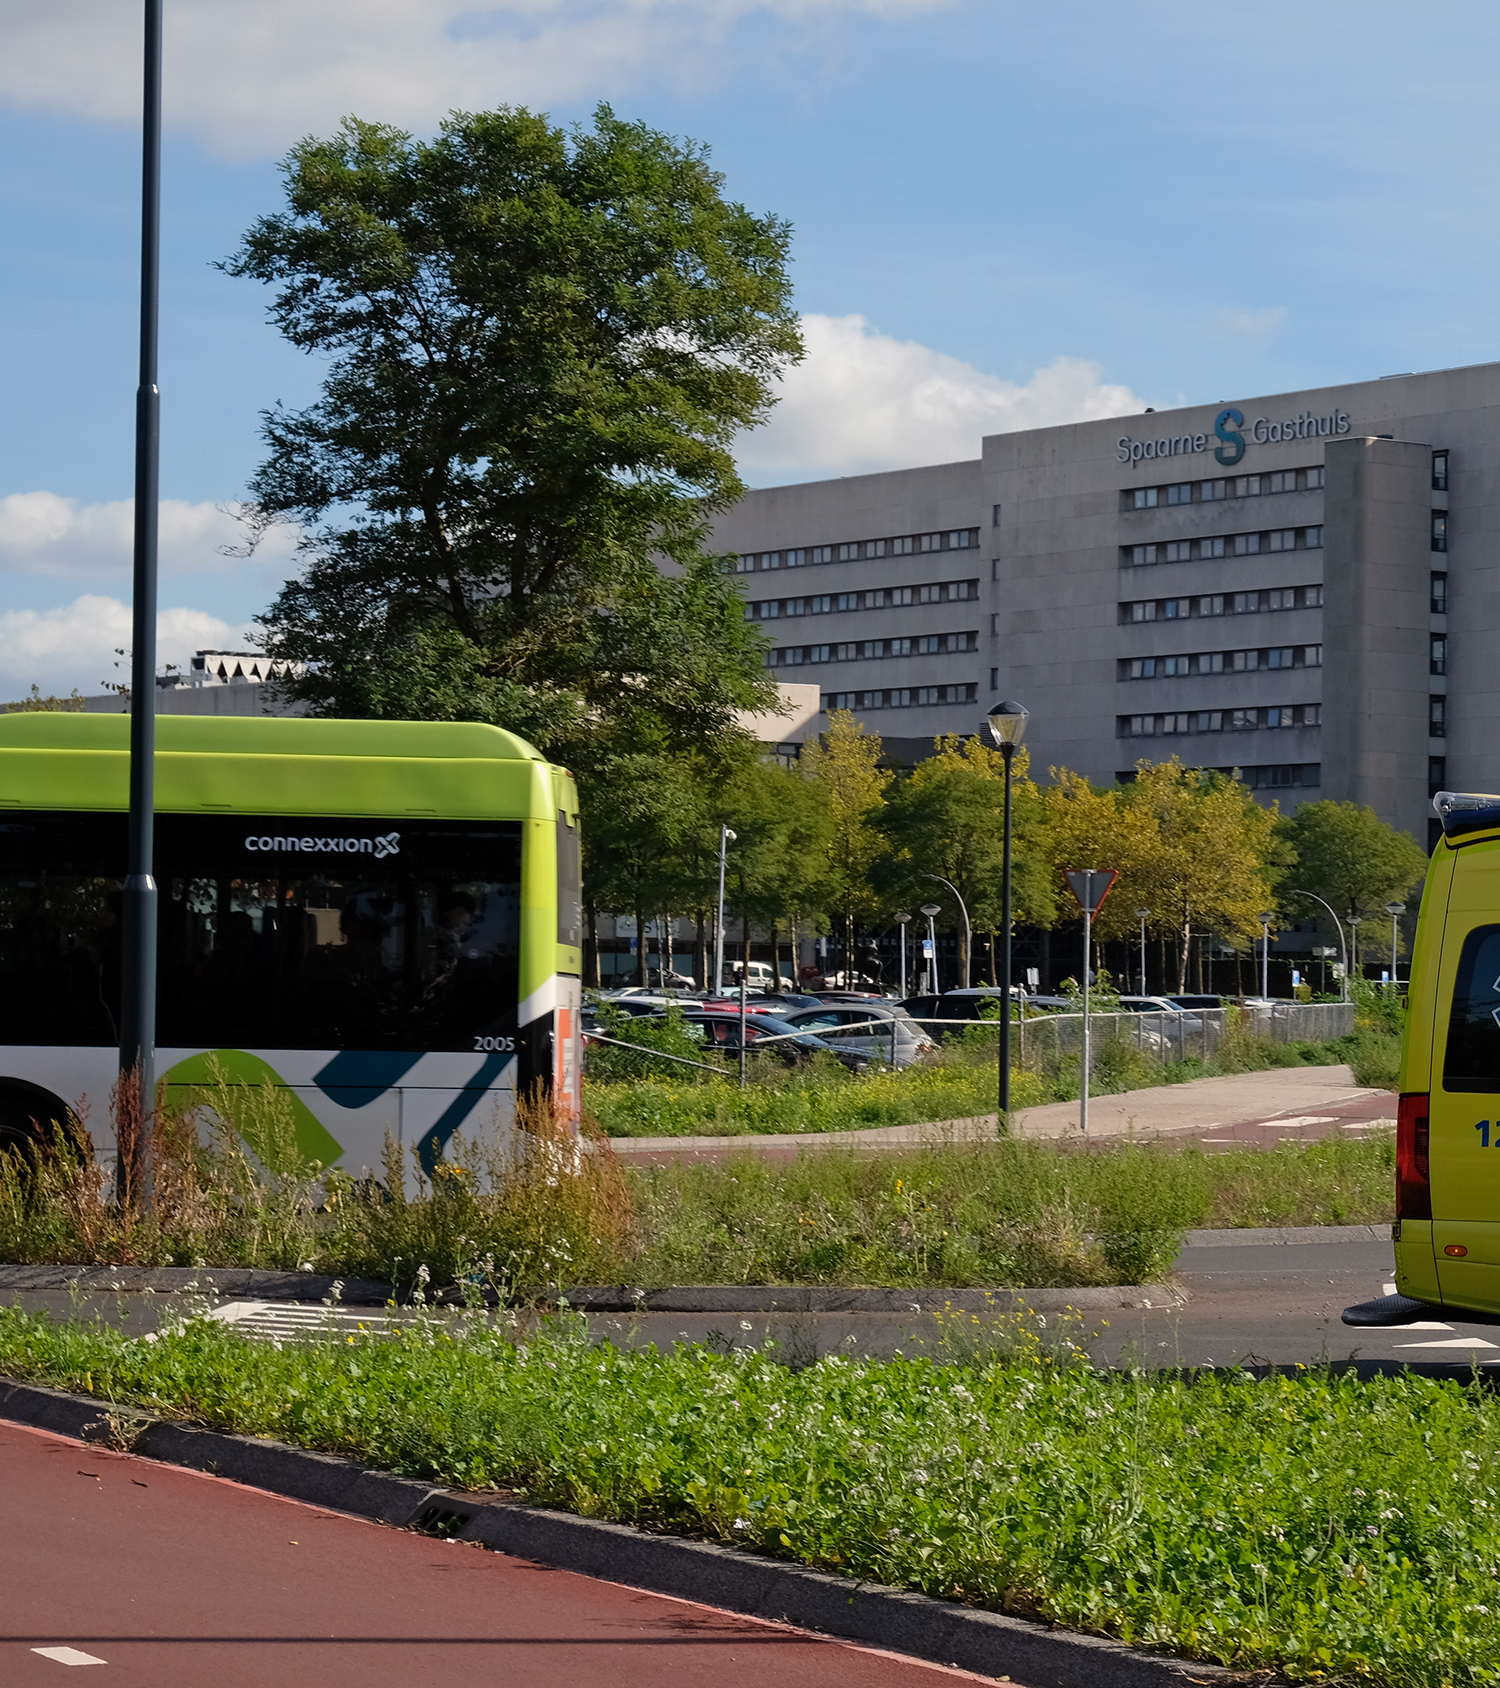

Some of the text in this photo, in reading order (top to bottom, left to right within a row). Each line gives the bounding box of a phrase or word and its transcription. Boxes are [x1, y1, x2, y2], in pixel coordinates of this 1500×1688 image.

[1116, 432, 1207, 468] Spaarne
[1251, 408, 1350, 444] Gasthuis
[244, 836, 373, 853] connexxion
[473, 1036, 515, 1051] 2005
